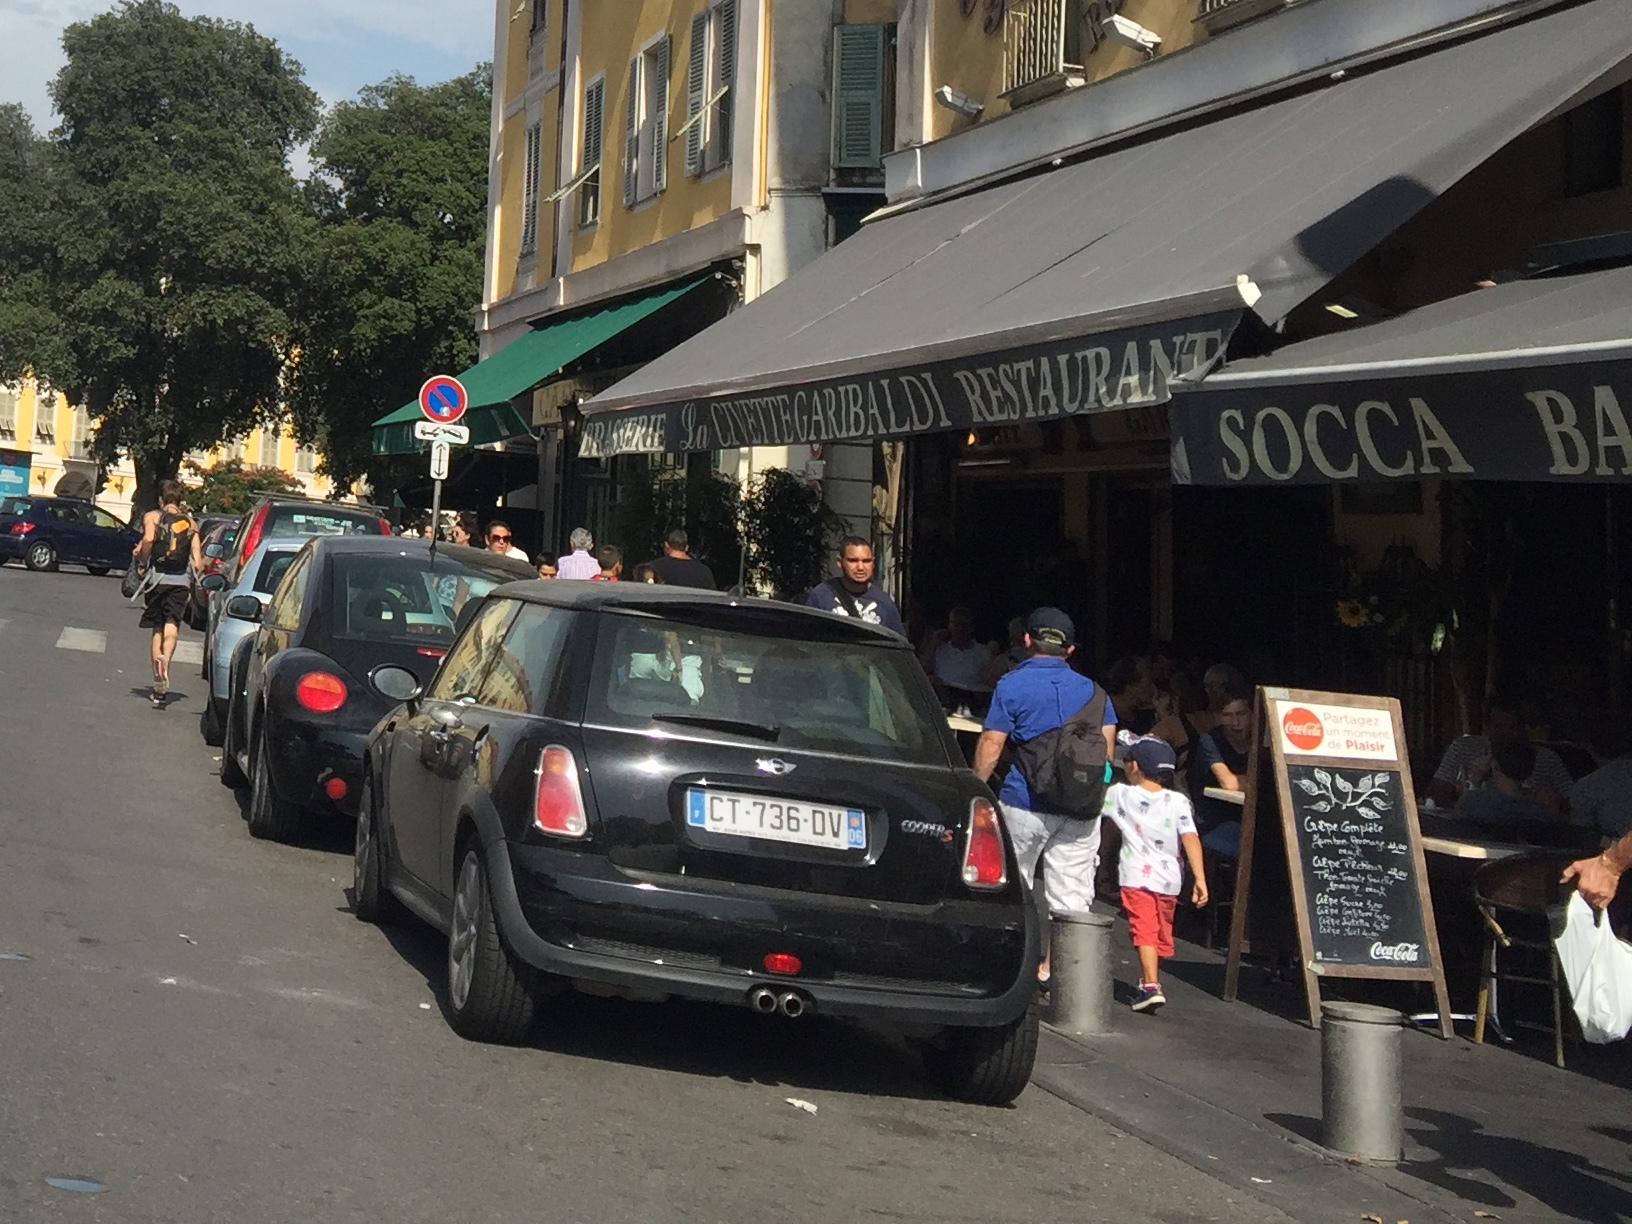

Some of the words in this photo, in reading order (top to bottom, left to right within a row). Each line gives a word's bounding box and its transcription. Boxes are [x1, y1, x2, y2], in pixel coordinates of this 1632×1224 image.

[578, 412, 667, 458] BRASSERIE
[794, 372, 952, 442] GARIBALDI
[953, 329, 1228, 424] RESTAURANT
[1219, 397, 1475, 481] SOCCA
[1323, 712, 1380, 727] Partagez
[1325, 728, 1340, 736] un
[1342, 729, 1390, 740] moment
[1327, 740, 1341, 750] de
[1345, 740, 1385, 753] Plaisir
[848, 828, 864, 844] 06
